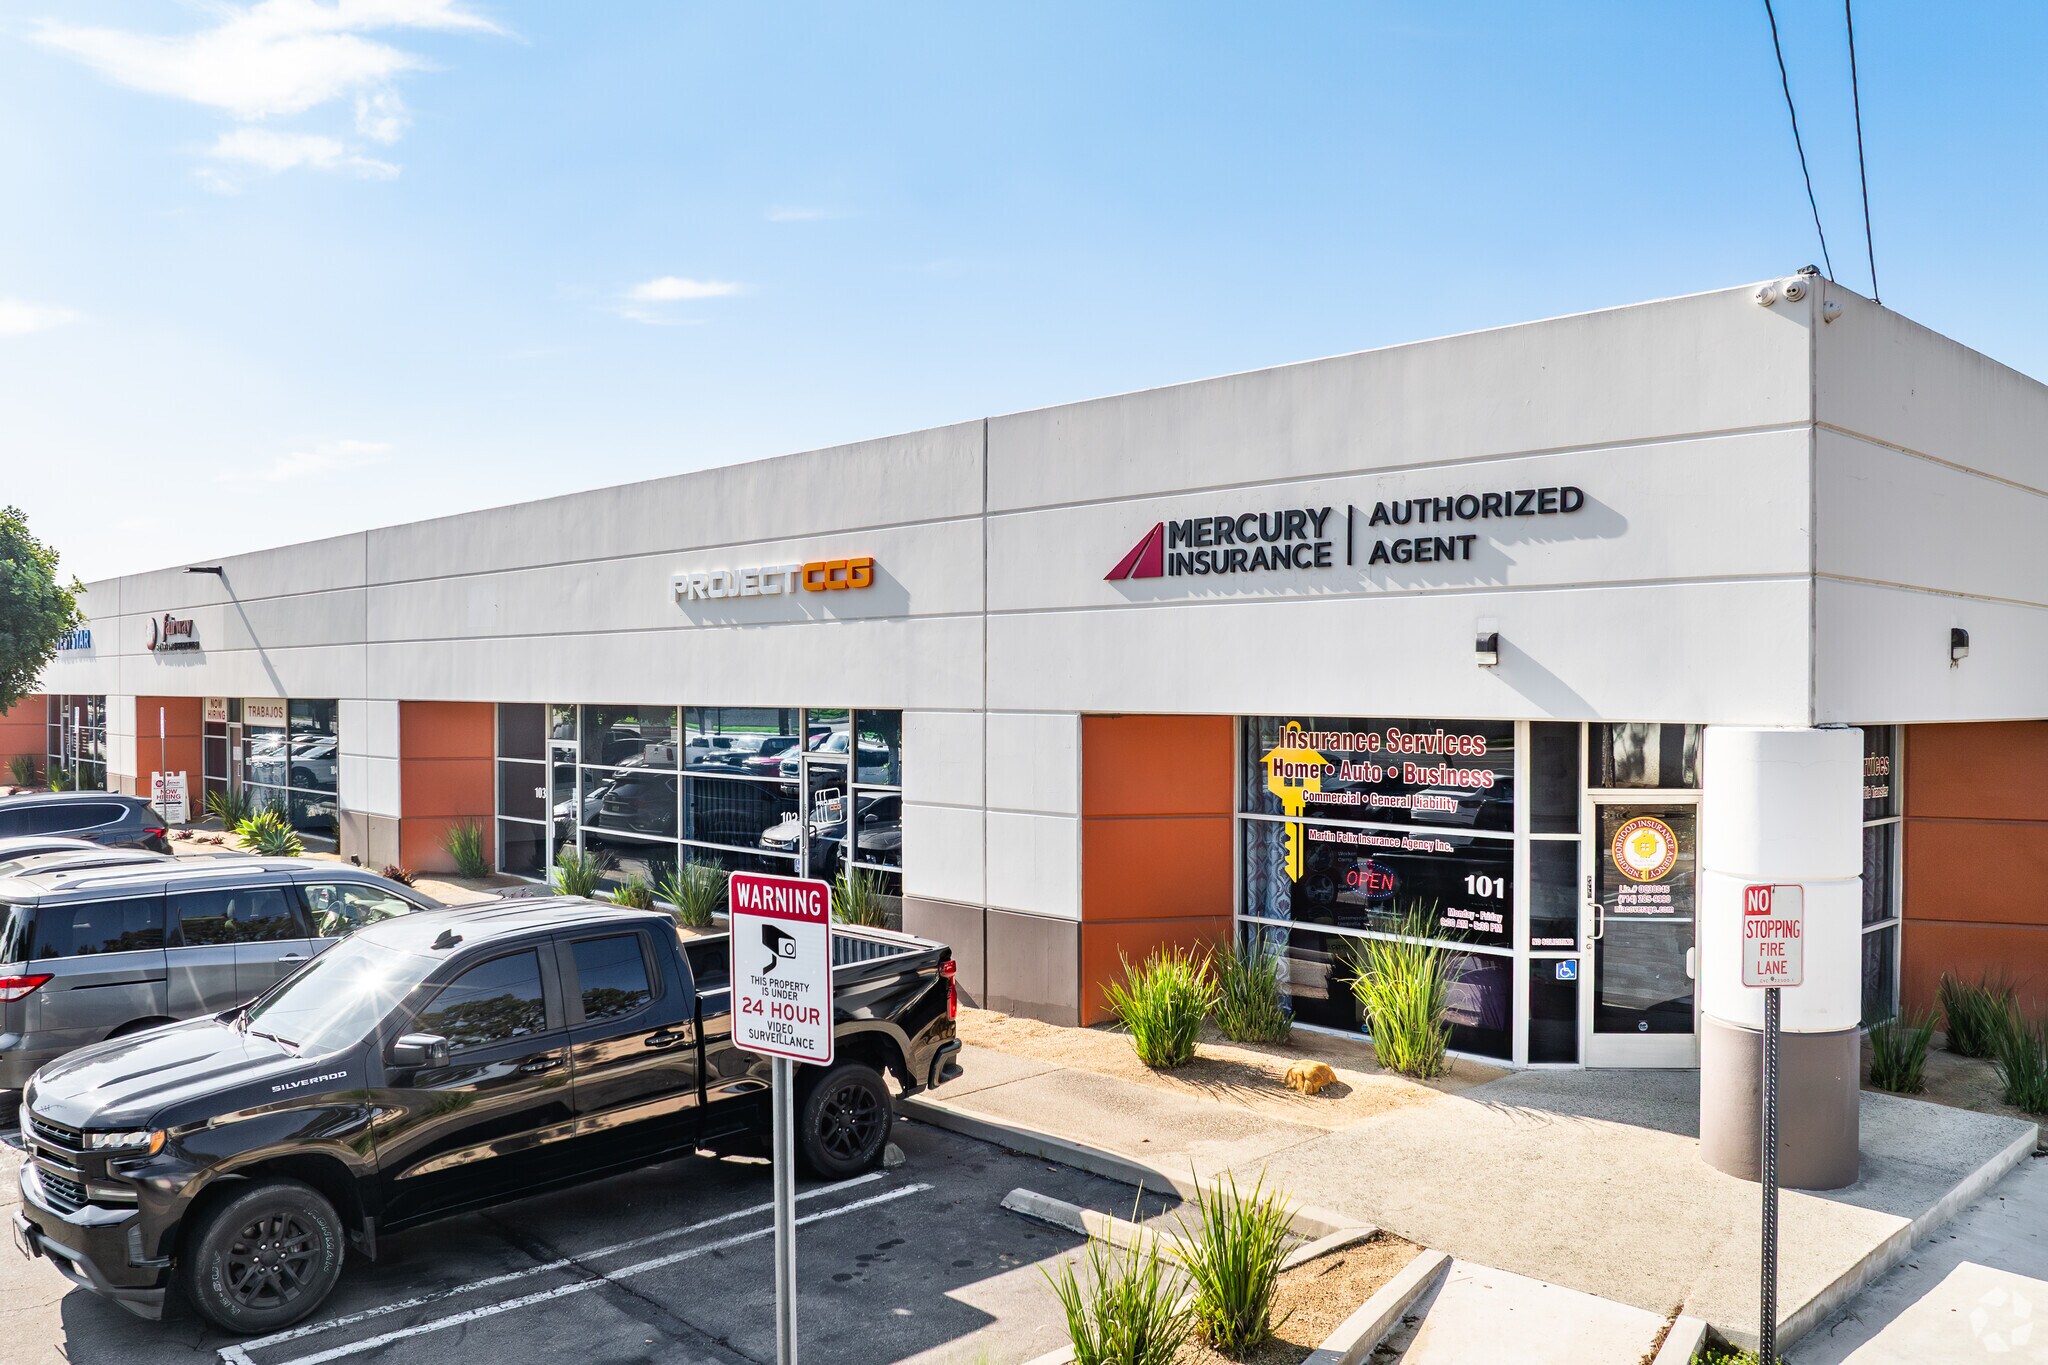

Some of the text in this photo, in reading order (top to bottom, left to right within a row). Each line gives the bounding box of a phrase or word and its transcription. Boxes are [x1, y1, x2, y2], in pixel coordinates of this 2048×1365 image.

[1368, 486, 1585, 527] AUTHORIZED
[1168, 506, 1332, 549] MERCURY
[1168, 541, 1332, 577] INSURANCE
[1368, 534, 1477, 565] AGENT
[671, 557, 874, 601] PROJECT CCG
[207, 709, 226, 720] HIRING
[210, 698, 223, 709] NOW
[248, 705, 284, 719] TRABAJOS
[1279, 725, 1487, 757] Insurance Services
[1273, 757, 1320, 780] Home
[1339, 760, 1382, 783] Auto
[1403, 762, 1495, 789] Business
[1302, 789, 1458, 813] Commercial General Liability
[1308, 829, 1454, 852] Martin Felix Insurance Agency Inc.
[1615, 820, 1675, 878] NEIGHBORHOOD INSURANCE AGENCY
[1346, 870, 1394, 891] OPEN
[1464, 874, 1504, 899] 101
[736, 882, 821, 917] WARNING
[1617, 894, 1637, 905] (714)
[1747, 889, 1770, 912] NO
[1447, 907, 1476, 920] Monday
[1479, 910, 1503, 923] Friday
[1455, 918, 1469, 929] AM
[1489, 922, 1503, 933] PM
[1746, 919, 1801, 939] STOPPING
[1531, 937, 1575, 946] NO SOLICITING
[1760, 942, 1786, 956] FIRE
[1757, 960, 1788, 975] LANE
[750, 974, 810, 993] THIS PROPERTY
[762, 986, 798, 1001] IS UNDER
[742, 996, 820, 1026] 24 HOUR
[767, 1020, 794, 1035] VIDEO
[748, 1028, 815, 1050] SURVEILLANCE
[271, 1070, 348, 1093] SILVERADO
